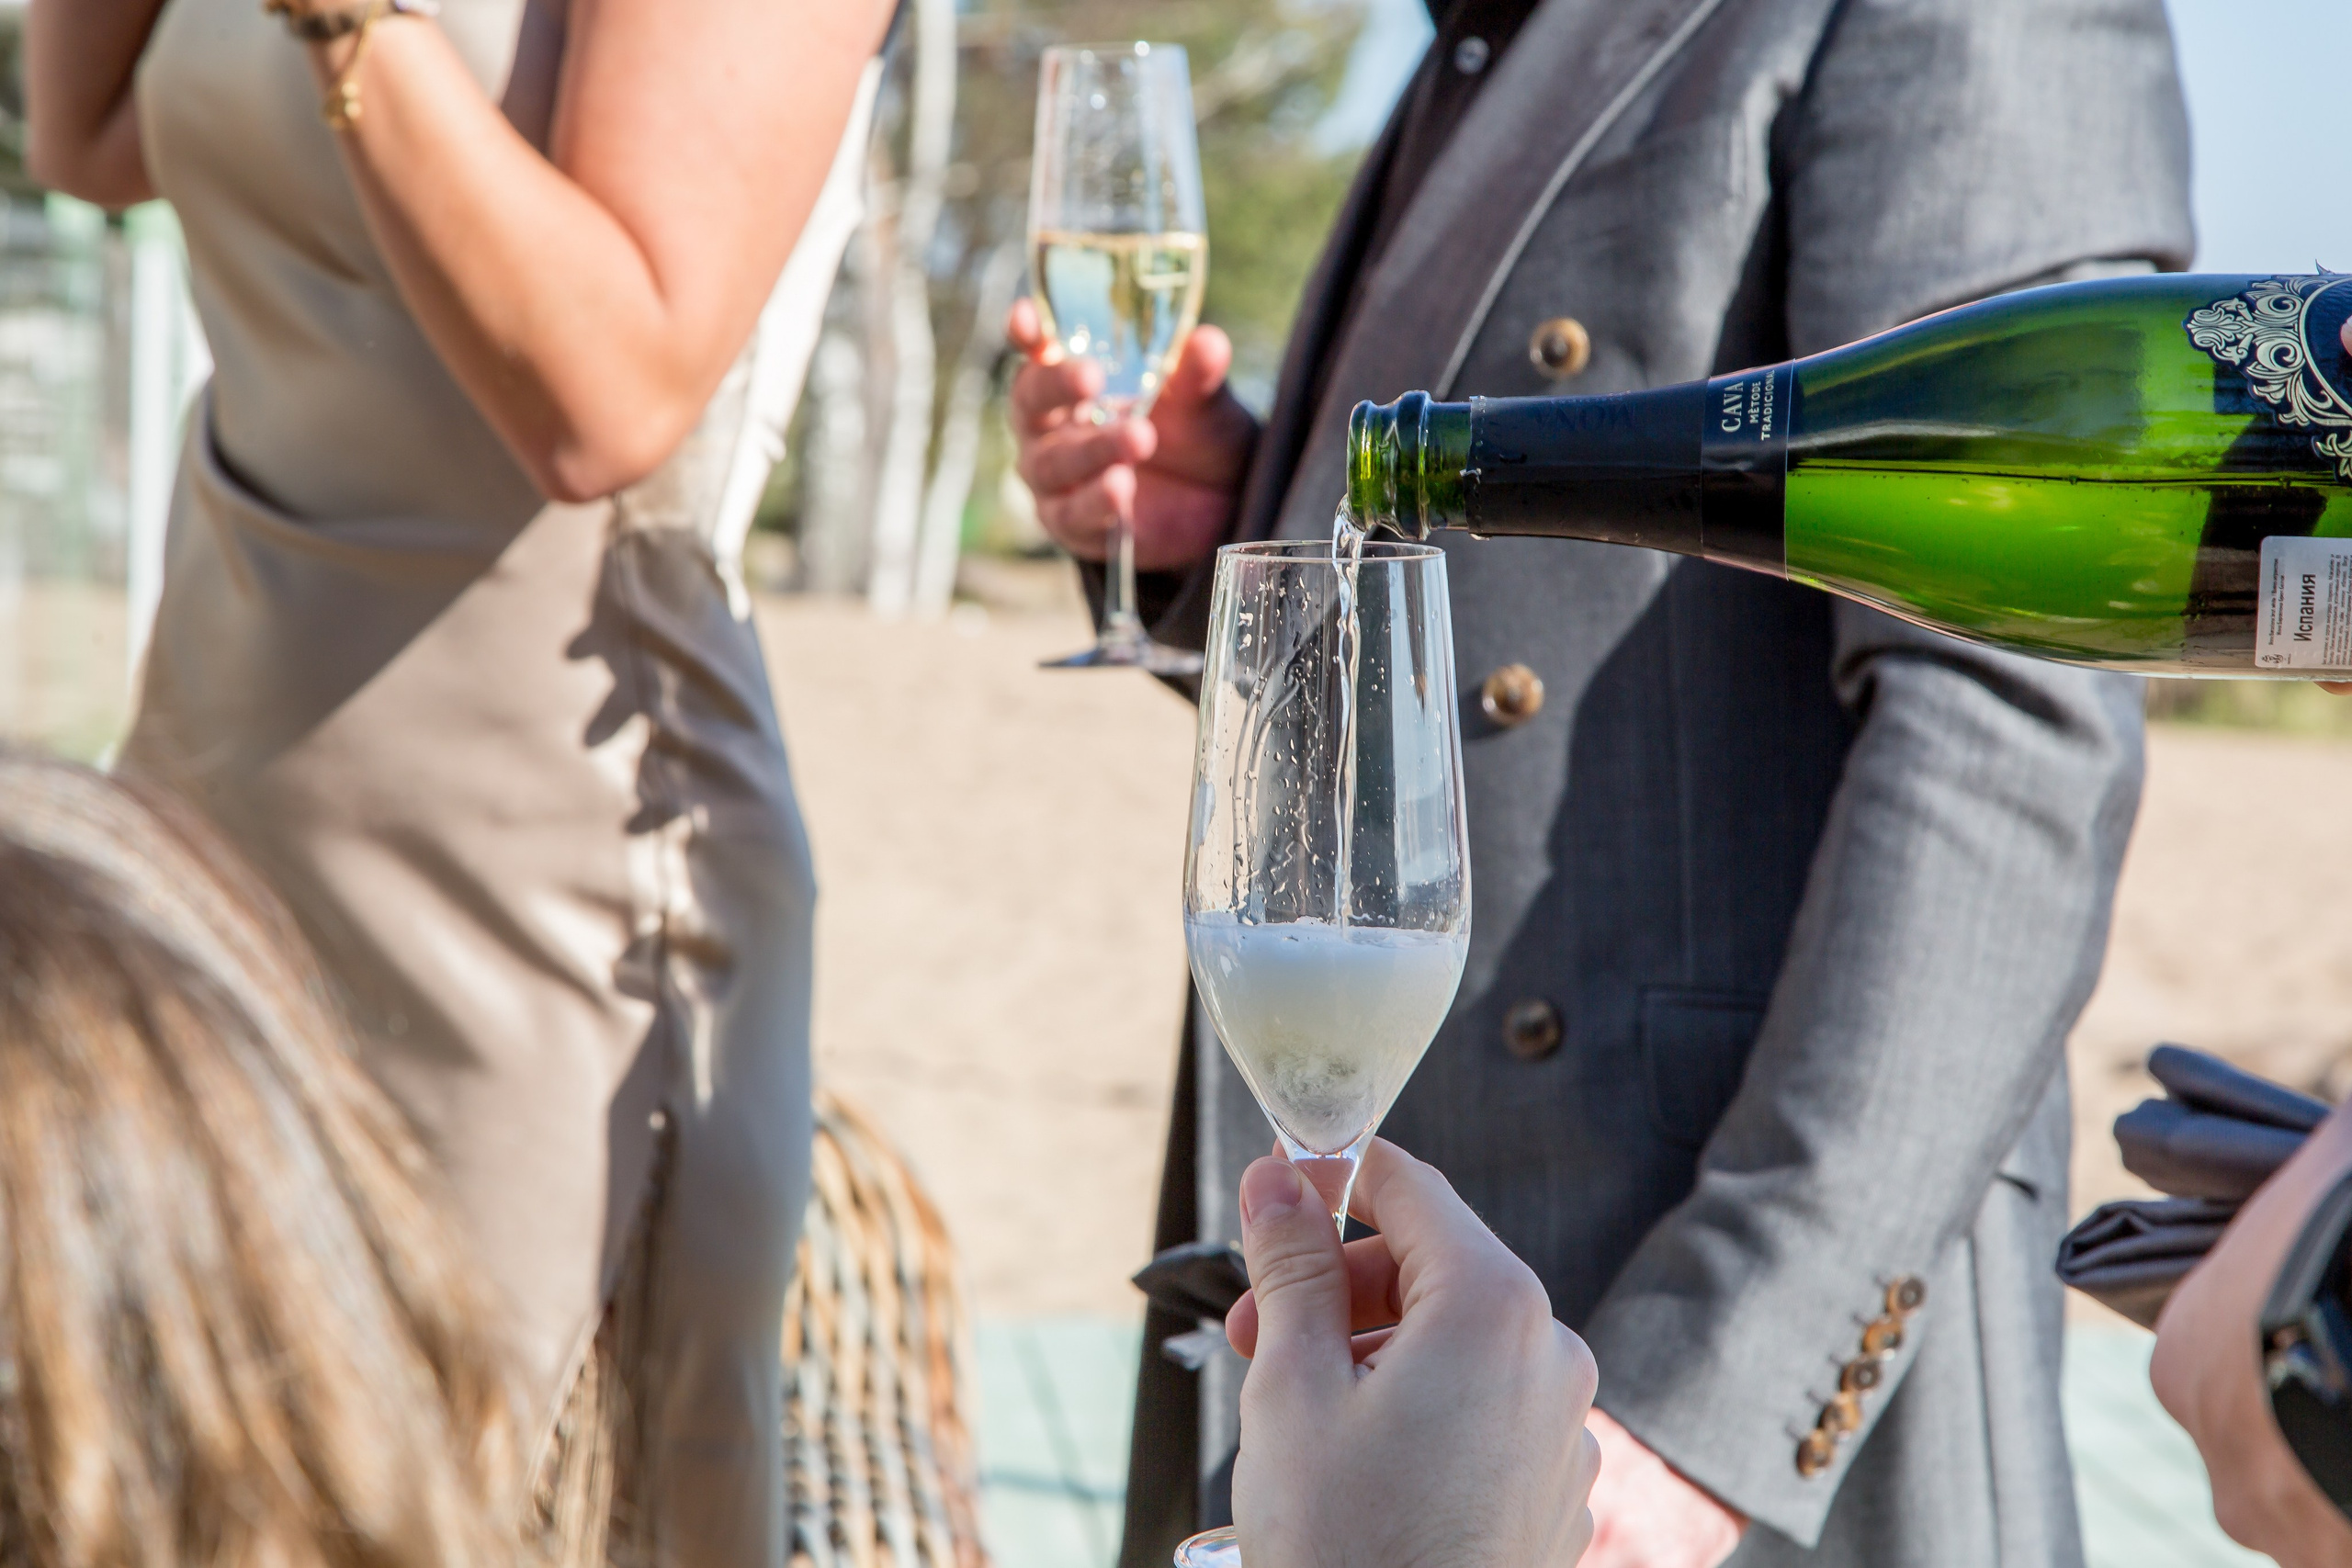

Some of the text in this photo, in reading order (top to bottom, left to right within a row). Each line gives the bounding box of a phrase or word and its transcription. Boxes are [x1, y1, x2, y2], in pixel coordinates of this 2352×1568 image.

[1722, 381, 1744, 432] CAVA
[1761, 370, 1775, 441] TRADICIONAL
[2294, 574, 2316, 641] Испания
